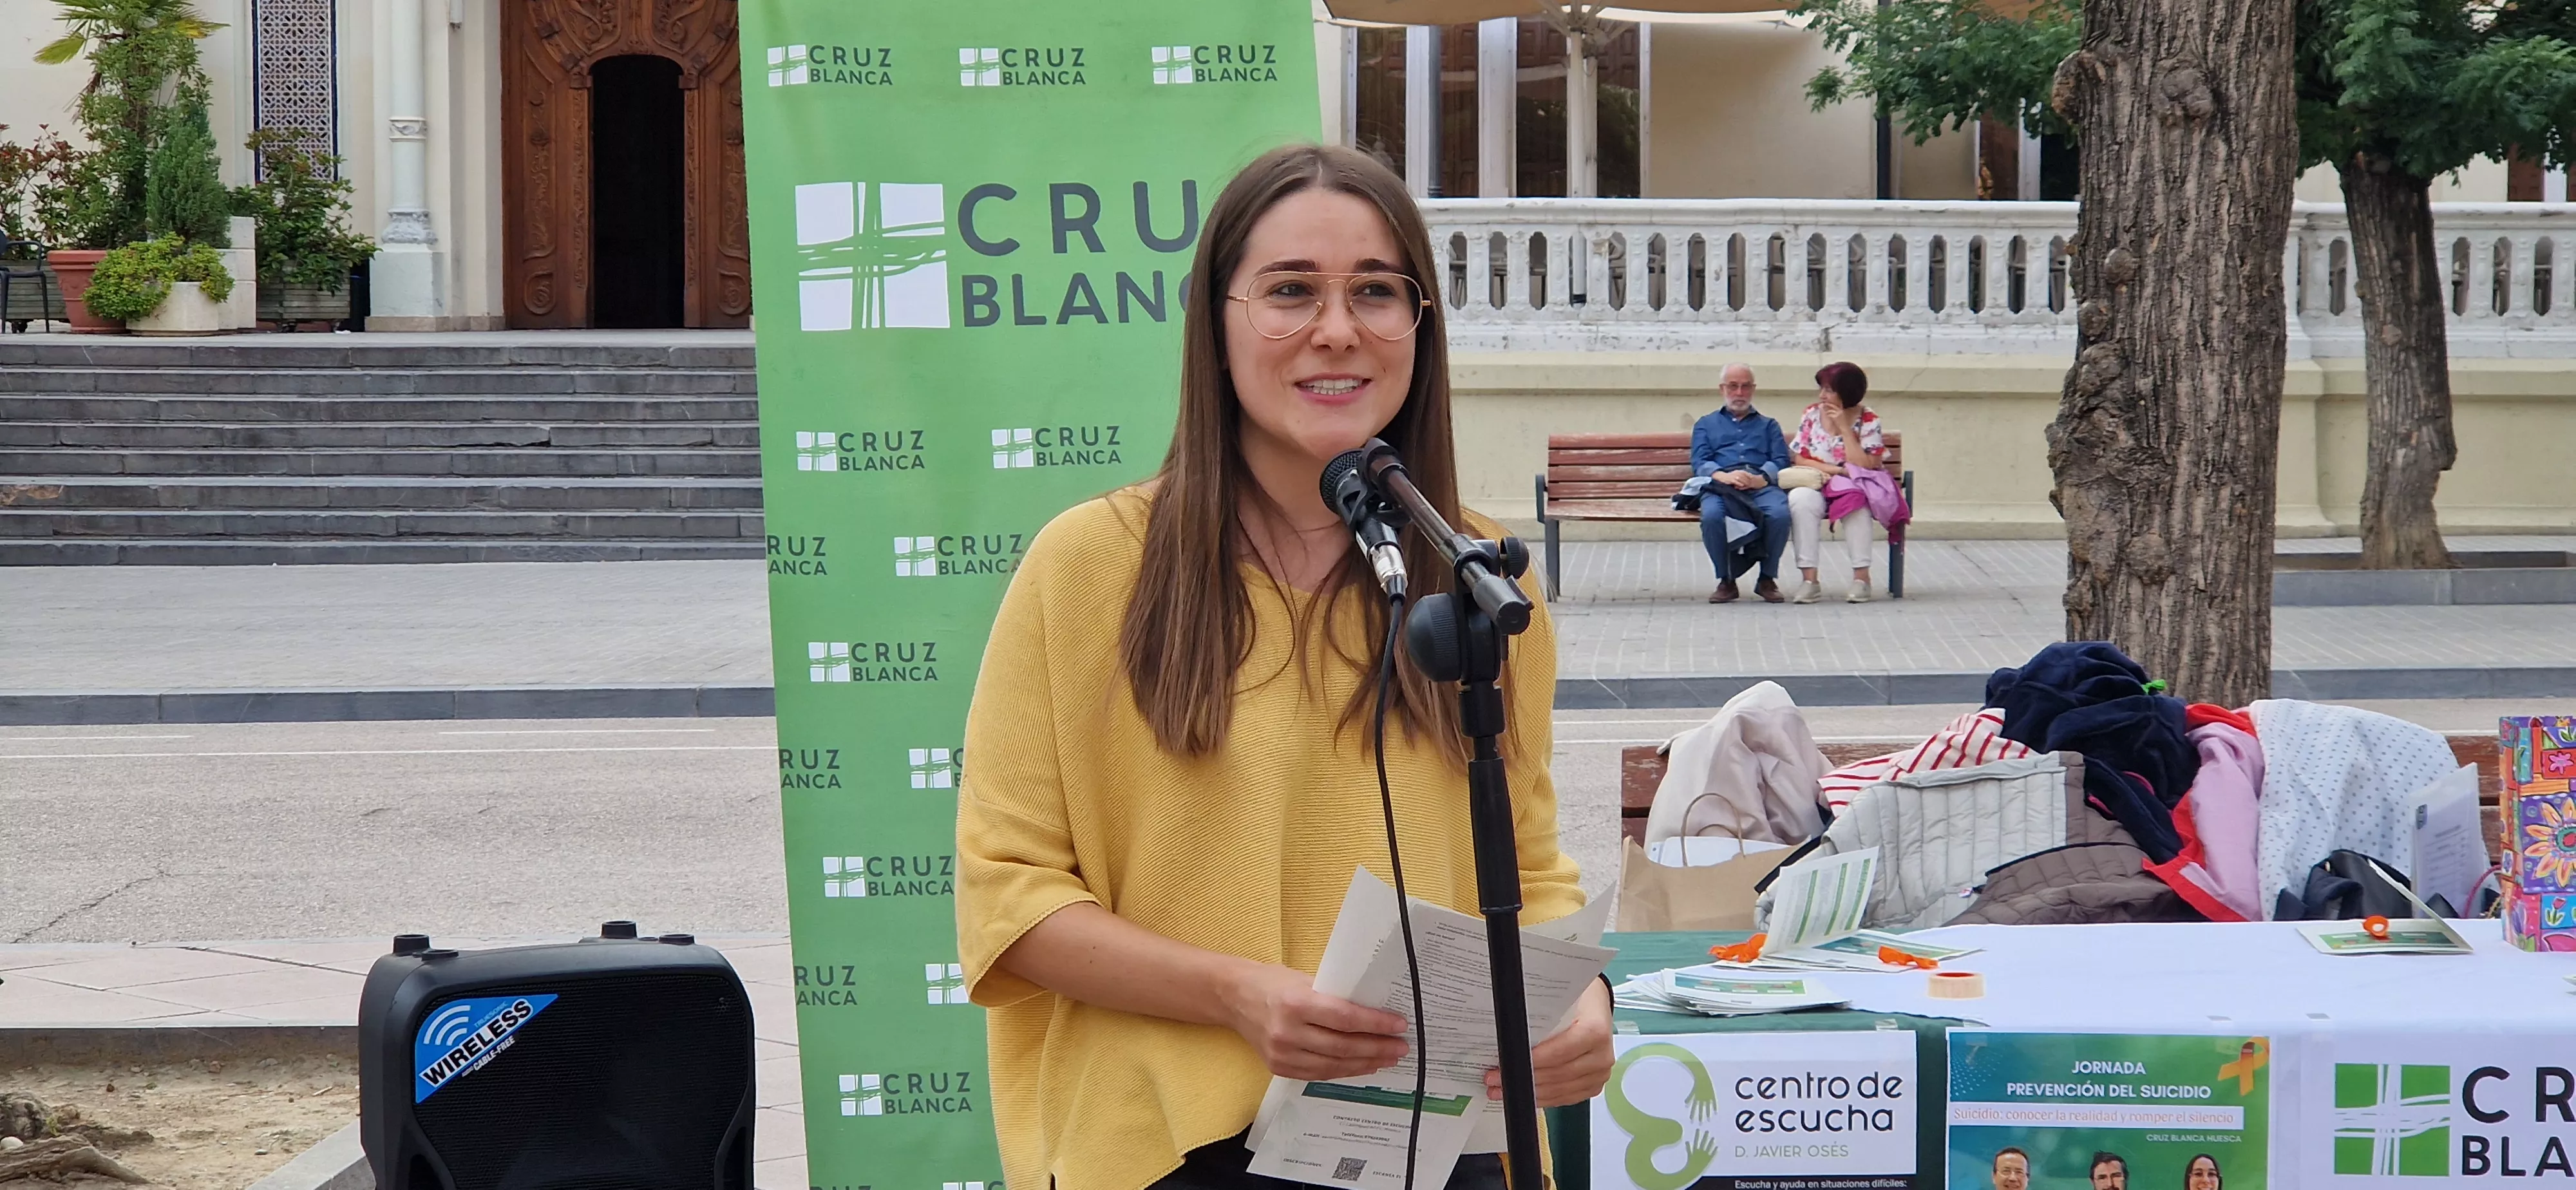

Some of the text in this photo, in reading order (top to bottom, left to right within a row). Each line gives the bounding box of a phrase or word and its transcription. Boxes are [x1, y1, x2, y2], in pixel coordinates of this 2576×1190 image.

[809, 44, 892, 68] CRUZ
[1001, 48, 1085, 68] CRUZ
[1193, 44, 1276, 65] CRUZ
[810, 68, 893, 86] BLANCA
[1002, 70, 1086, 86] BLANCA
[1195, 67, 1278, 82] BLANCA
[961, 270, 1189, 328] BLAN
[838, 430, 924, 453] CRUZ
[1036, 426, 1121, 448] CRUZ
[839, 454, 925, 471] BLANCA
[1036, 449, 1122, 467] BLANCA
[937, 534, 1023, 556] CRUZ
[851, 642, 937, 663] CRUZ
[852, 666, 938, 682] BLANCA
[866, 855, 953, 877] CRUZ
[867, 880, 954, 896] BLANCA
[422, 999, 532, 1086] WIRELESS
[473, 1035, 515, 1071] CABLE-FREE
[2072, 1061, 2146, 1075] JORNADA
[883, 1072, 971, 1094] CRUZ
[1735, 1071, 1903, 1100] centro de
[2007, 1080, 2211, 1099] PREVENCIÓN DEL SUICIDIO
[884, 1097, 972, 1114] BLANCA
[1735, 1104, 1893, 1133] escucha
[1954, 1108, 2233, 1125] Suicidio: conocer la realidad y romper el silencio
[1735, 1140, 1849, 1158] D. JAVIER OSÉS
[1735, 1180, 1771, 1189] Escucha
[1772, 1182, 1779, 1190] y
[1779, 1180, 1806, 1190] ayuda
[1820, 1180, 1870, 1189] situaciones
[1871, 1178, 1907, 1188] difíciles:
